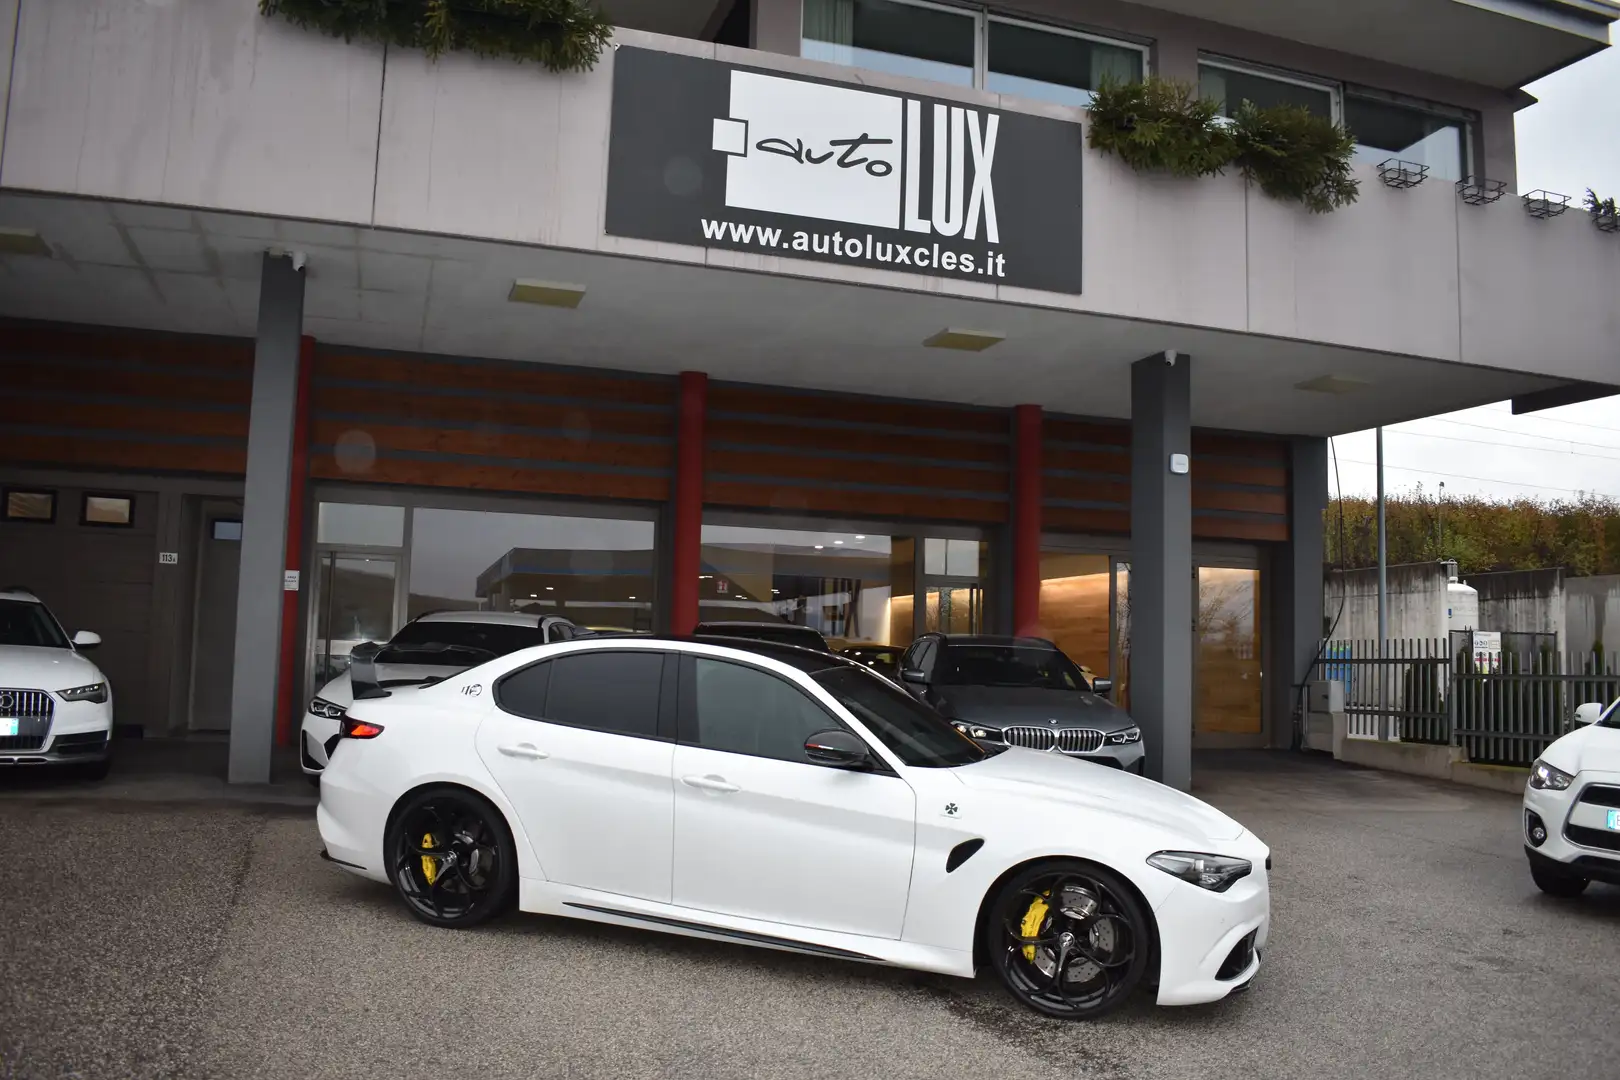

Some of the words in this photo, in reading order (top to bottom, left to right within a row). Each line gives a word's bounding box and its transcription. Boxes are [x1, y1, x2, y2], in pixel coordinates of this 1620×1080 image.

[756, 133, 893, 177] auto
[905, 99, 999, 243] LUX
[701, 218, 1006, 278] www.autoluxcles.it
